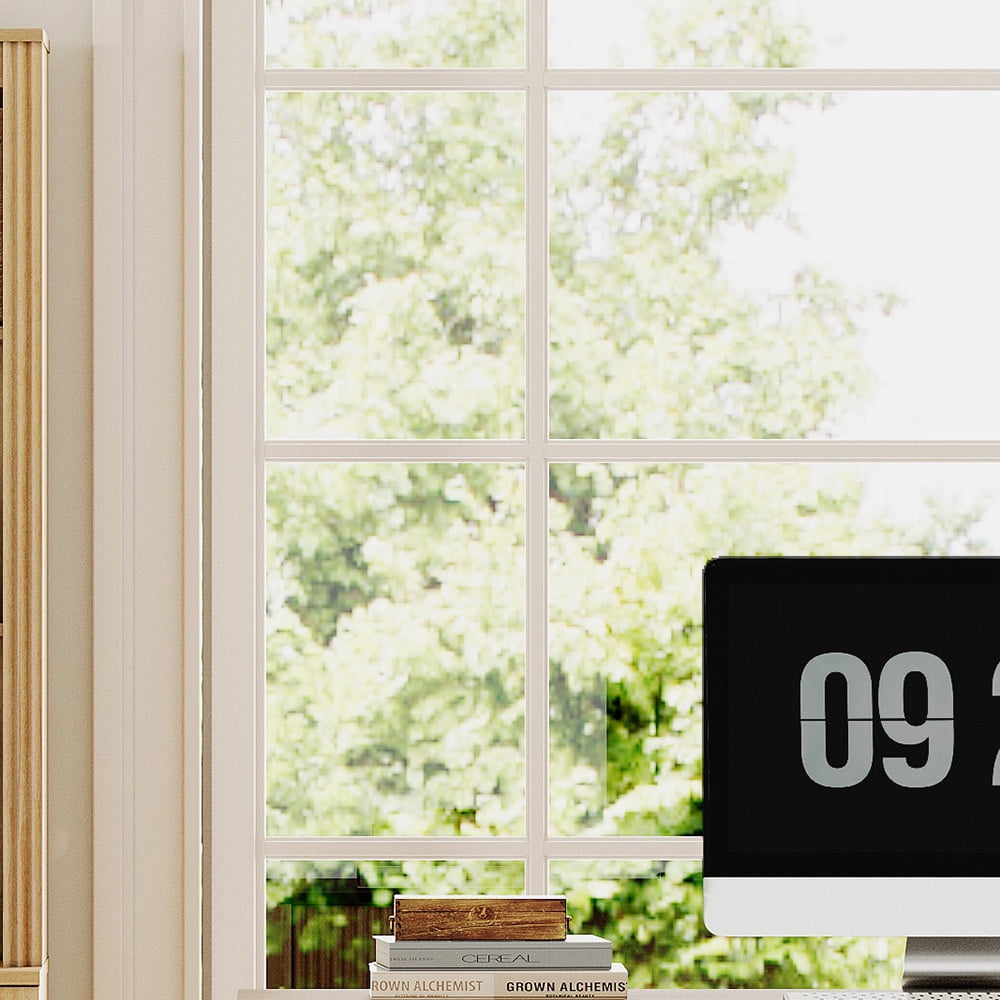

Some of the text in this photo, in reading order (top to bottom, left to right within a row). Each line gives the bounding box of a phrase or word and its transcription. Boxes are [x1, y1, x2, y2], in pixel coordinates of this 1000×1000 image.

[800, 651, 955, 788] 09
[461, 954, 540, 964] CEREAL
[413, 980, 483, 992] ALCHEMIST
[506, 981, 628, 992] GROWN ALCHEMIS
